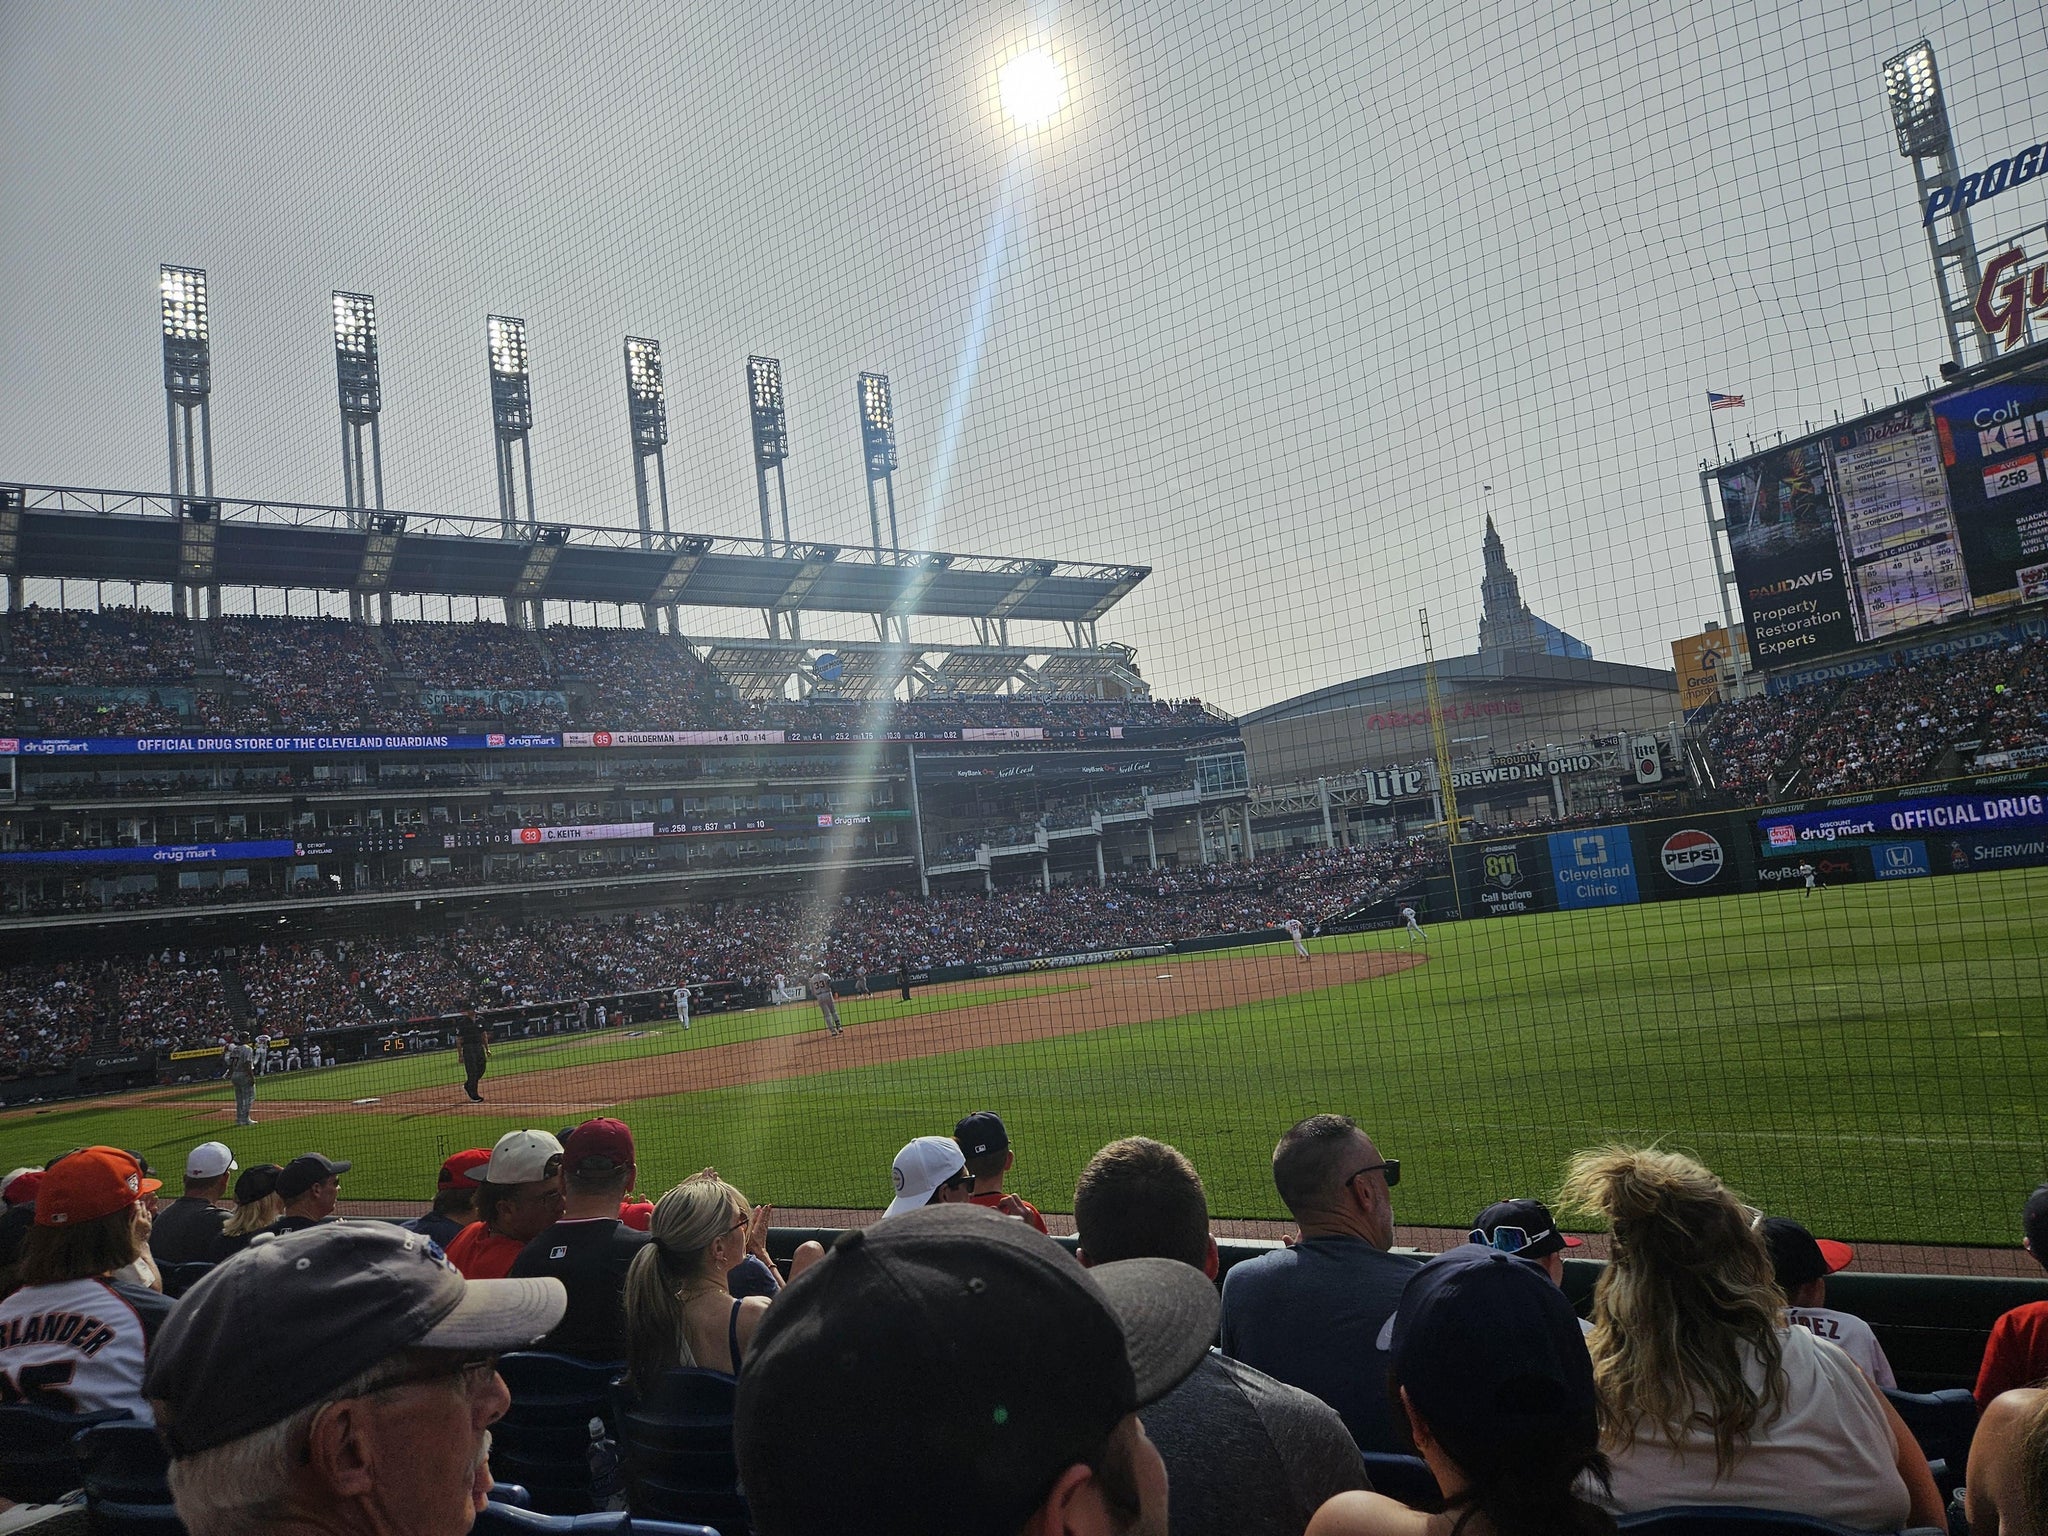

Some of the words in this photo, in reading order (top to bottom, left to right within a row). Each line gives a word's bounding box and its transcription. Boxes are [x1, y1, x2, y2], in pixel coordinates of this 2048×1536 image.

[1922, 141, 2048, 228] PROG
[1973, 399, 2021, 428] Colt
[1866, 416, 1914, 443] Detroit
[1997, 469, 2029, 491] .258
[1866, 511, 1904, 526] TORKELSON
[1753, 599, 1818, 623] Property
[1756, 610, 1841, 640] Restoration
[1759, 633, 1816, 655] Experts
[1911, 630, 2009, 660] HONDA
[1796, 657, 1883, 686] HONDA
[1462, 701, 1522, 719] Arena
[137, 739, 194, 750] OFFICIAL
[198, 738, 232, 750] DRUG
[235, 738, 273, 749] STORE
[276, 738, 291, 749] OF
[292, 738, 315, 749] THE
[318, 737, 382, 748] CLEVELAND
[385, 736, 448, 748] GUARDIANS
[508, 737, 532, 747] drug
[533, 736, 555, 745] mart
[596, 734, 609, 744] 35
[618, 735, 626, 743] C.
[628, 735, 675, 743] HOLDERMAN
[24, 741, 55, 754] drug
[57, 742, 88, 751] mart
[1634, 743, 1655, 760] Lite
[1493, 752, 1540, 767] PROUDLY
[957, 769, 983, 777] KeyBank
[1082, 765, 1104, 773] KeyBank
[1451, 764, 1521, 788] BREWED
[1524, 763, 1544, 778] IN
[1547, 755, 1592, 775] OHIO
[1975, 771, 2030, 786] PROGRESSIVE
[1362, 768, 1423, 806] Lite
[1898, 783, 1949, 797] PROGRESSIVE
[1827, 794, 1874, 807] PROGRESSIVE
[1761, 803, 1806, 816] PROGRESSIVE
[1890, 804, 1981, 831] OFFICIAL
[1983, 795, 2044, 821] DRUG
[670, 824, 686, 833] .258
[703, 822, 718, 831] .637
[756, 820, 765, 828] 10
[834, 817, 852, 826] drug
[1819, 819, 1851, 828] DISCOUNT
[524, 831, 537, 841] 33
[547, 831, 556, 839] C.
[557, 830, 581, 838] KEITH
[1770, 827, 1790, 839] drug
[1801, 827, 1836, 841] drug
[1837, 820, 1875, 837] mart
[153, 850, 183, 862] drug
[186, 848, 216, 858] mart
[1664, 850, 1721, 865] PEPSI
[1485, 854, 1517, 877] 811
[1758, 865, 1802, 881] KeyBa
[1879, 866, 1926, 876] HONDA
[1559, 864, 1630, 883] Cleveland
[1481, 892, 1500, 903] Call
[1501, 890, 1533, 901] before
[1576, 884, 1617, 899] Clinic
[1490, 903, 1508, 914] you
[1508, 901, 1527, 911] dig.
[814, 980, 826, 990] 33
